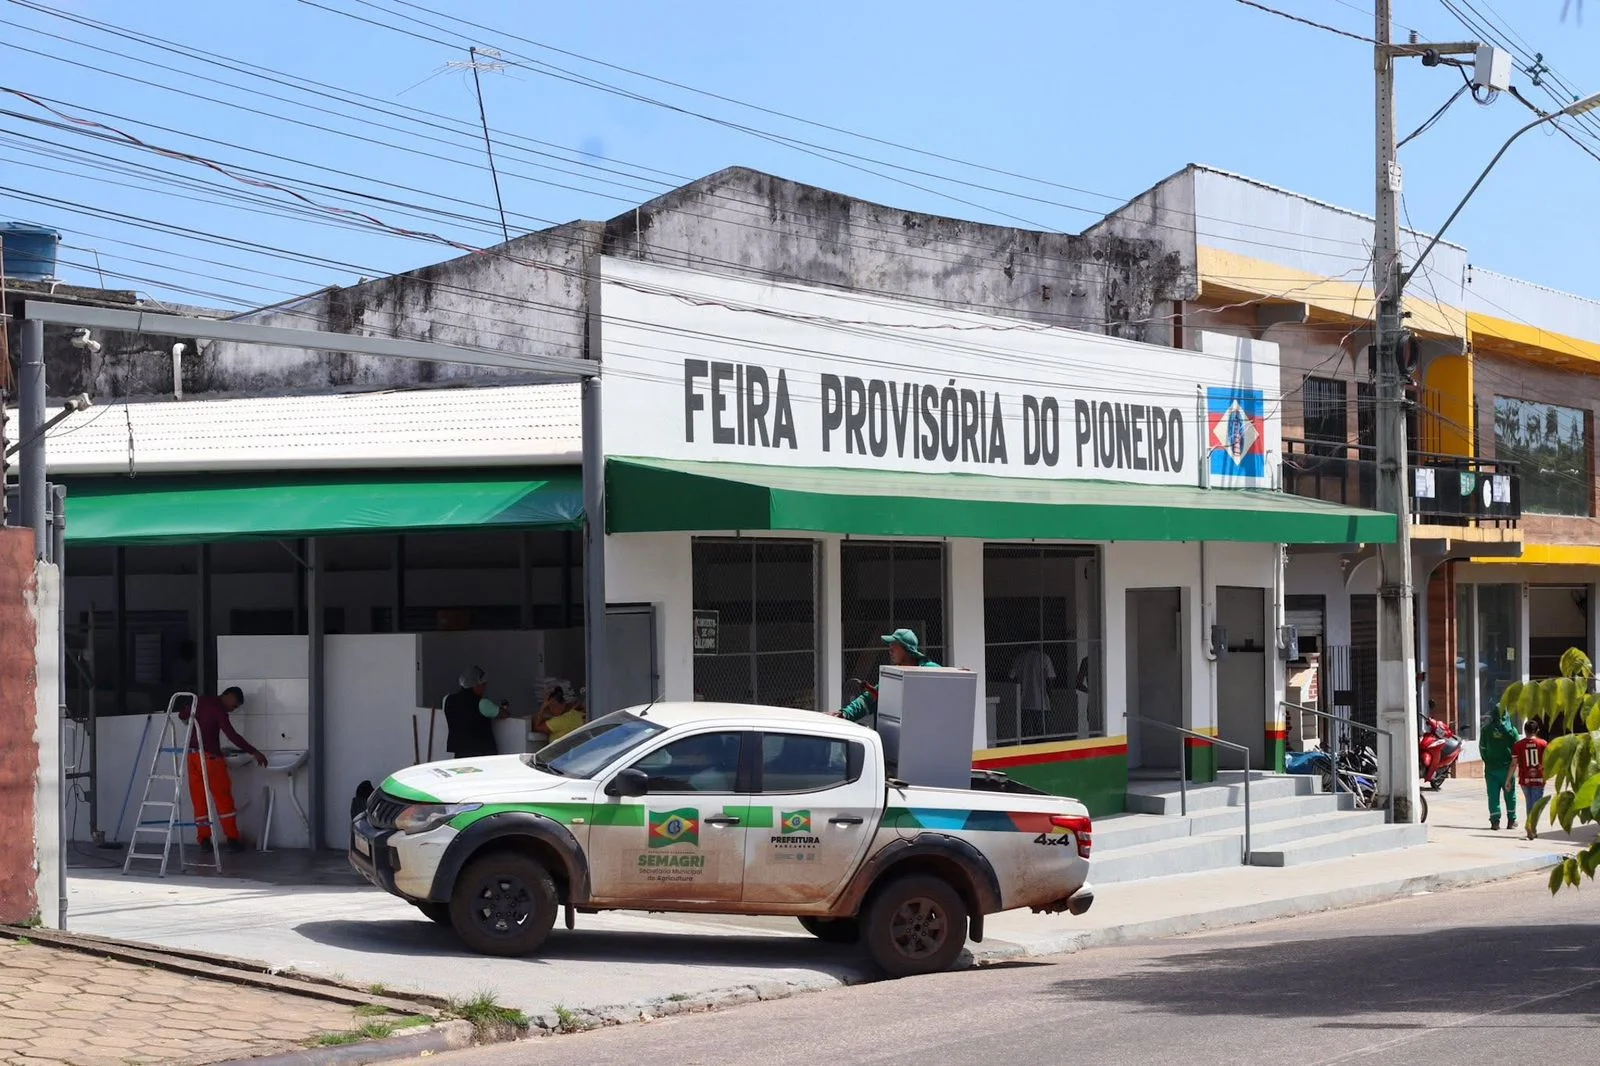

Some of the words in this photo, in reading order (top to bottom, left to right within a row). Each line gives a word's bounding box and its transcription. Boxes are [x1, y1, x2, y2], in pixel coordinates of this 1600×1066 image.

[684, 358, 798, 449] FEIRA
[821, 373, 1008, 464] PROVISÓRIA
[1022, 394, 1059, 467] DO
[1074, 398, 1184, 473] PIONEIRO
[1525, 748, 1539, 767] 10
[770, 836, 820, 844] PREFEITURA
[1033, 832, 1070, 847] 4x4
[637, 854, 705, 867] SEMAGRI
